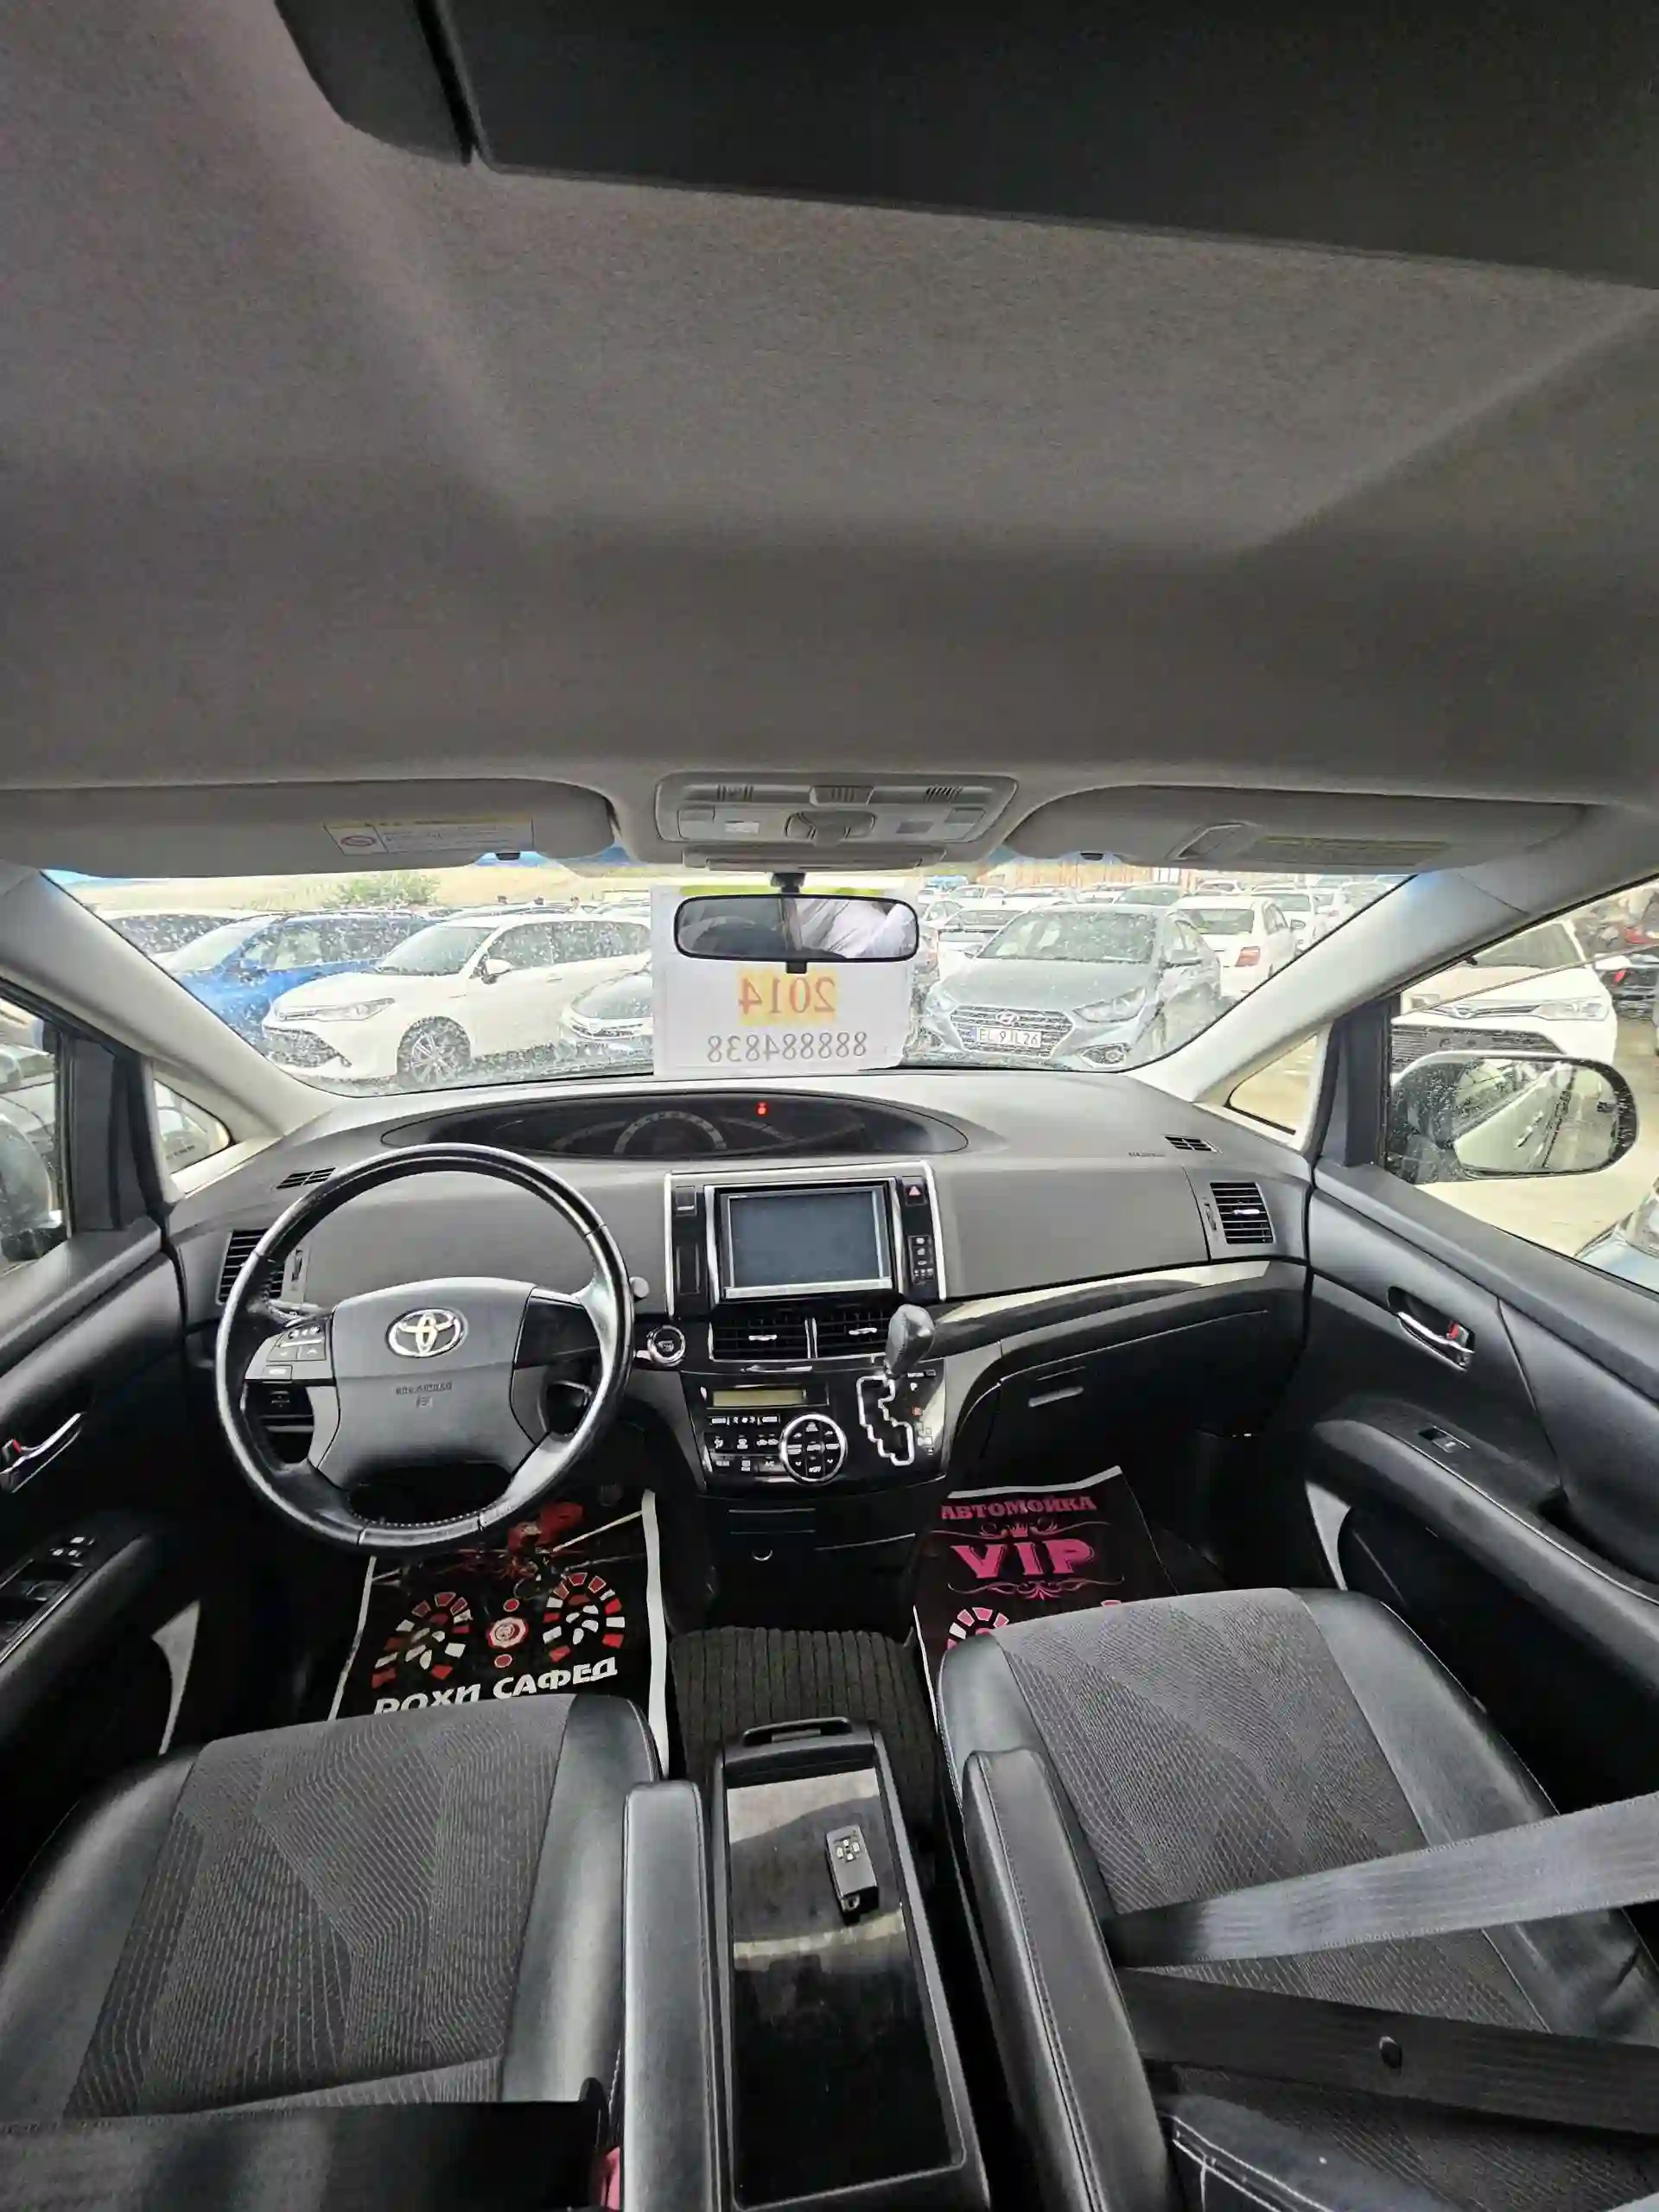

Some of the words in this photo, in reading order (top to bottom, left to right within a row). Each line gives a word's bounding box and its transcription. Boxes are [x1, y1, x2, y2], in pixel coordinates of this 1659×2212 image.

[941, 1496, 1097, 1520] АВТОМОЙКА
[950, 1539, 1095, 1580] VIP
[493, 1656, 618, 1700] САФЕД
